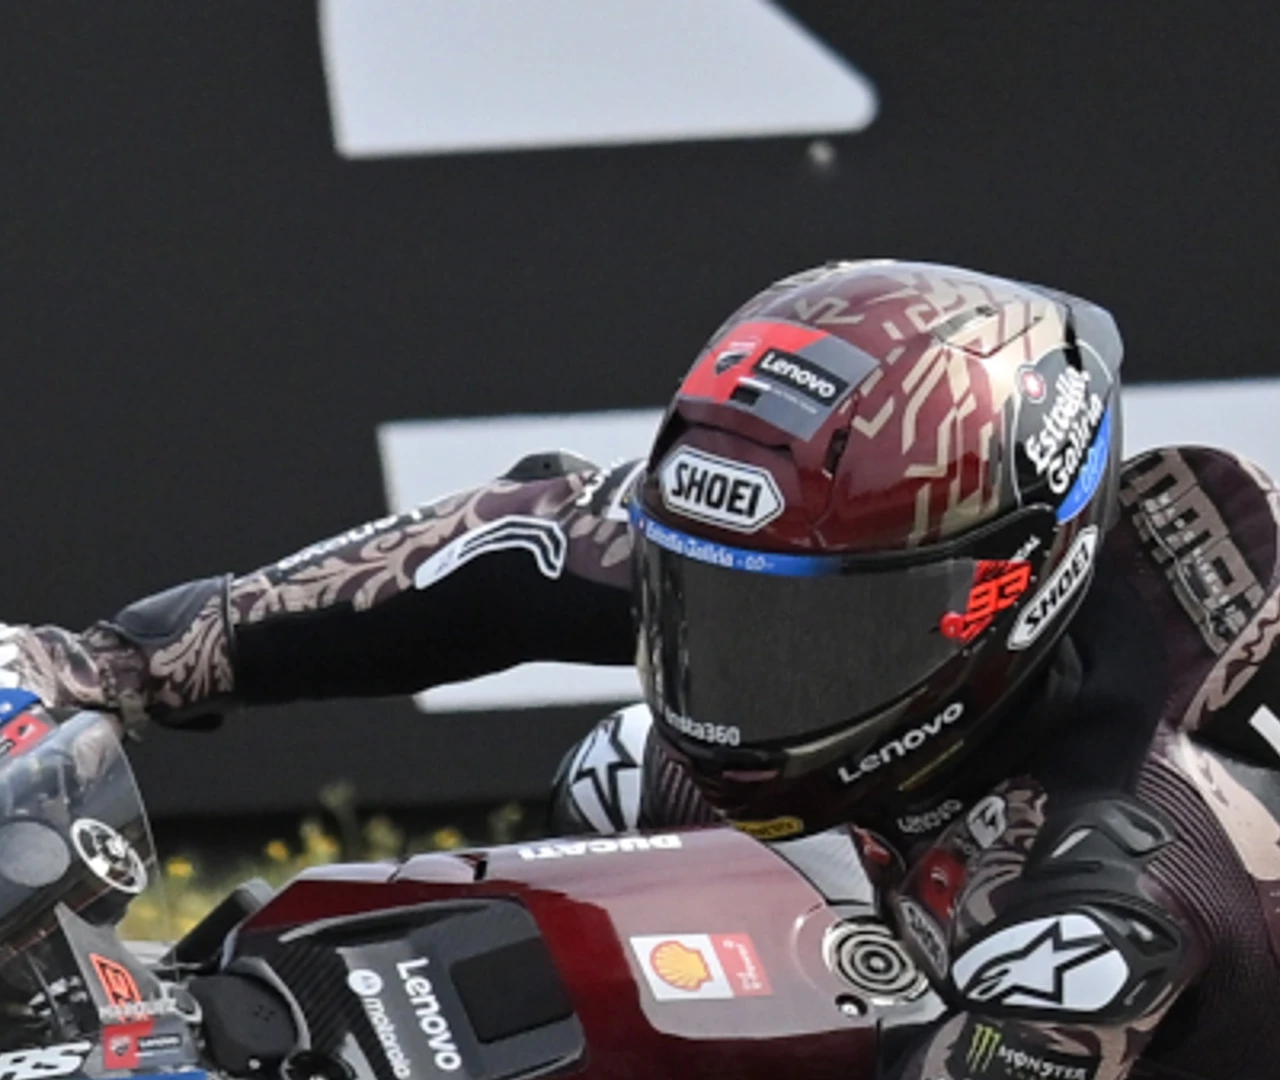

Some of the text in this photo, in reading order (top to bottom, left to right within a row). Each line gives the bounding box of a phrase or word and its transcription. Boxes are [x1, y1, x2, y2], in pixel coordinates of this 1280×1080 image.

[760, 352, 836, 398] Lenovo
[671, 461, 762, 518] SHOEI
[1024, 541, 1090, 629] SHOEI
[838, 701, 965, 784] Lenovo
[518, 834, 684, 861] DUCATI
[363, 997, 411, 1080] motorola
[396, 957, 462, 1071] Lenovo
